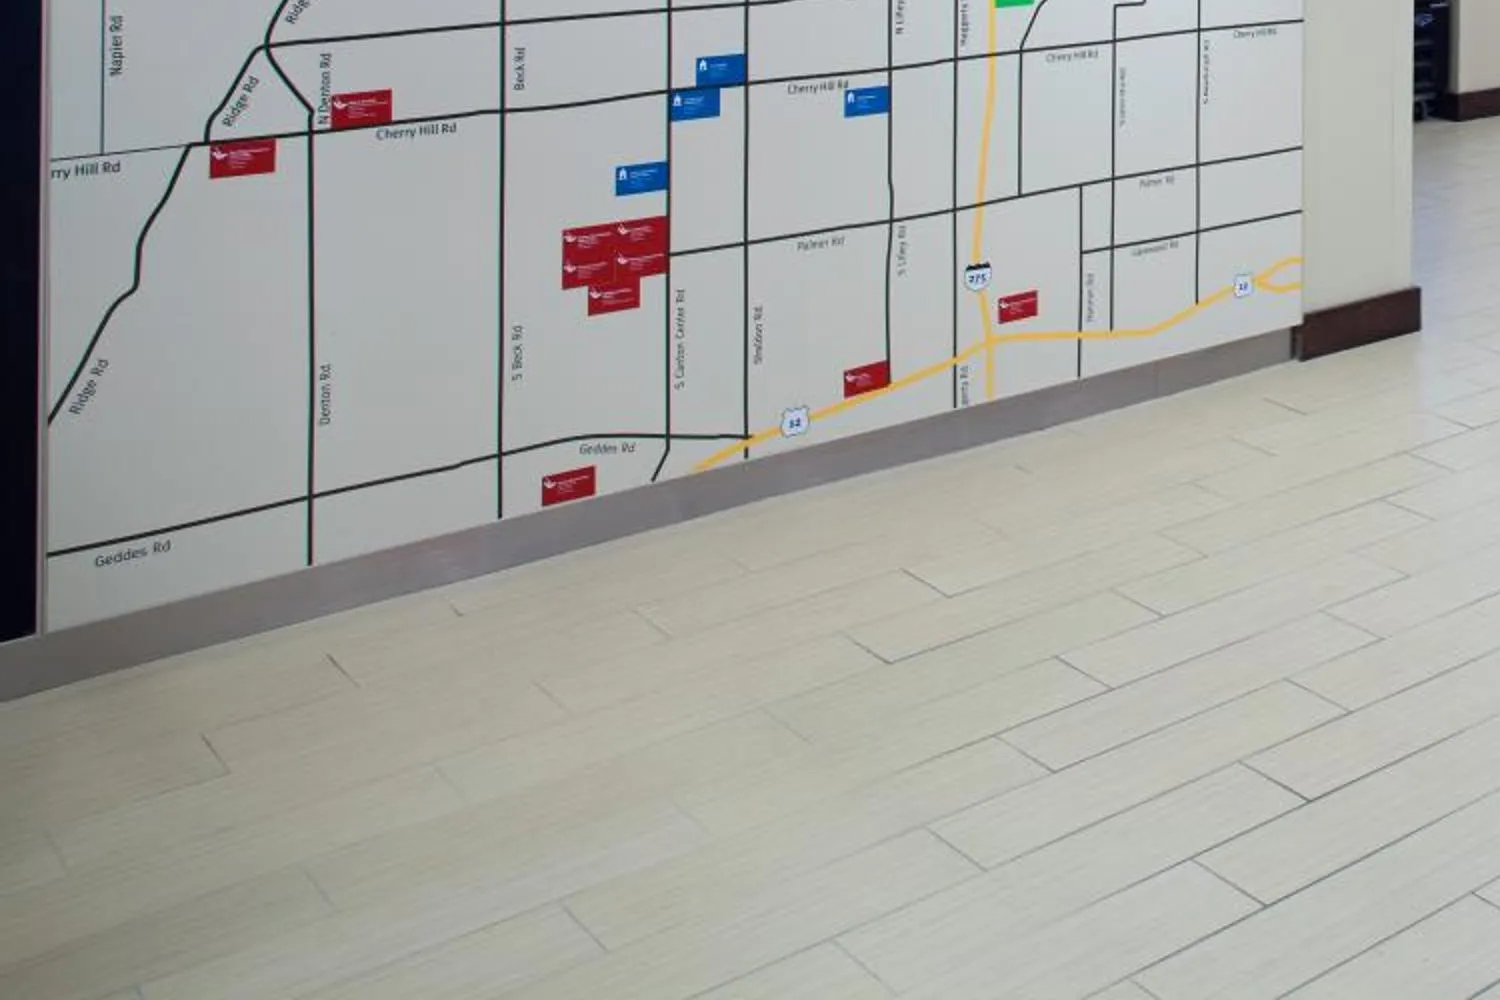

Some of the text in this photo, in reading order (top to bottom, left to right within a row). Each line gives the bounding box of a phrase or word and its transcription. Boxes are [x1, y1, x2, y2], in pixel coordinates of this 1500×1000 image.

[109, 16, 124, 78] Napier Rd
[319, 52, 332, 70] Rd
[514, 48, 526, 91] Beck Rd
[222, 76, 260, 128] Ridge Rd
[318, 72, 331, 115] Denton
[375, 122, 457, 141] Cherry Hill Rd
[74, 163, 99, 177] Hill
[102, 162, 121, 174] Rd
[968, 273, 987, 284] 275
[512, 326, 523, 340] Rd
[512, 342, 522, 372] Beck
[68, 358, 109, 416] Ridge Rd
[320, 364, 332, 426] Denton Rd
[579, 442, 636, 455] Geddes Rd
[94, 540, 172, 568] Geddes Rd
